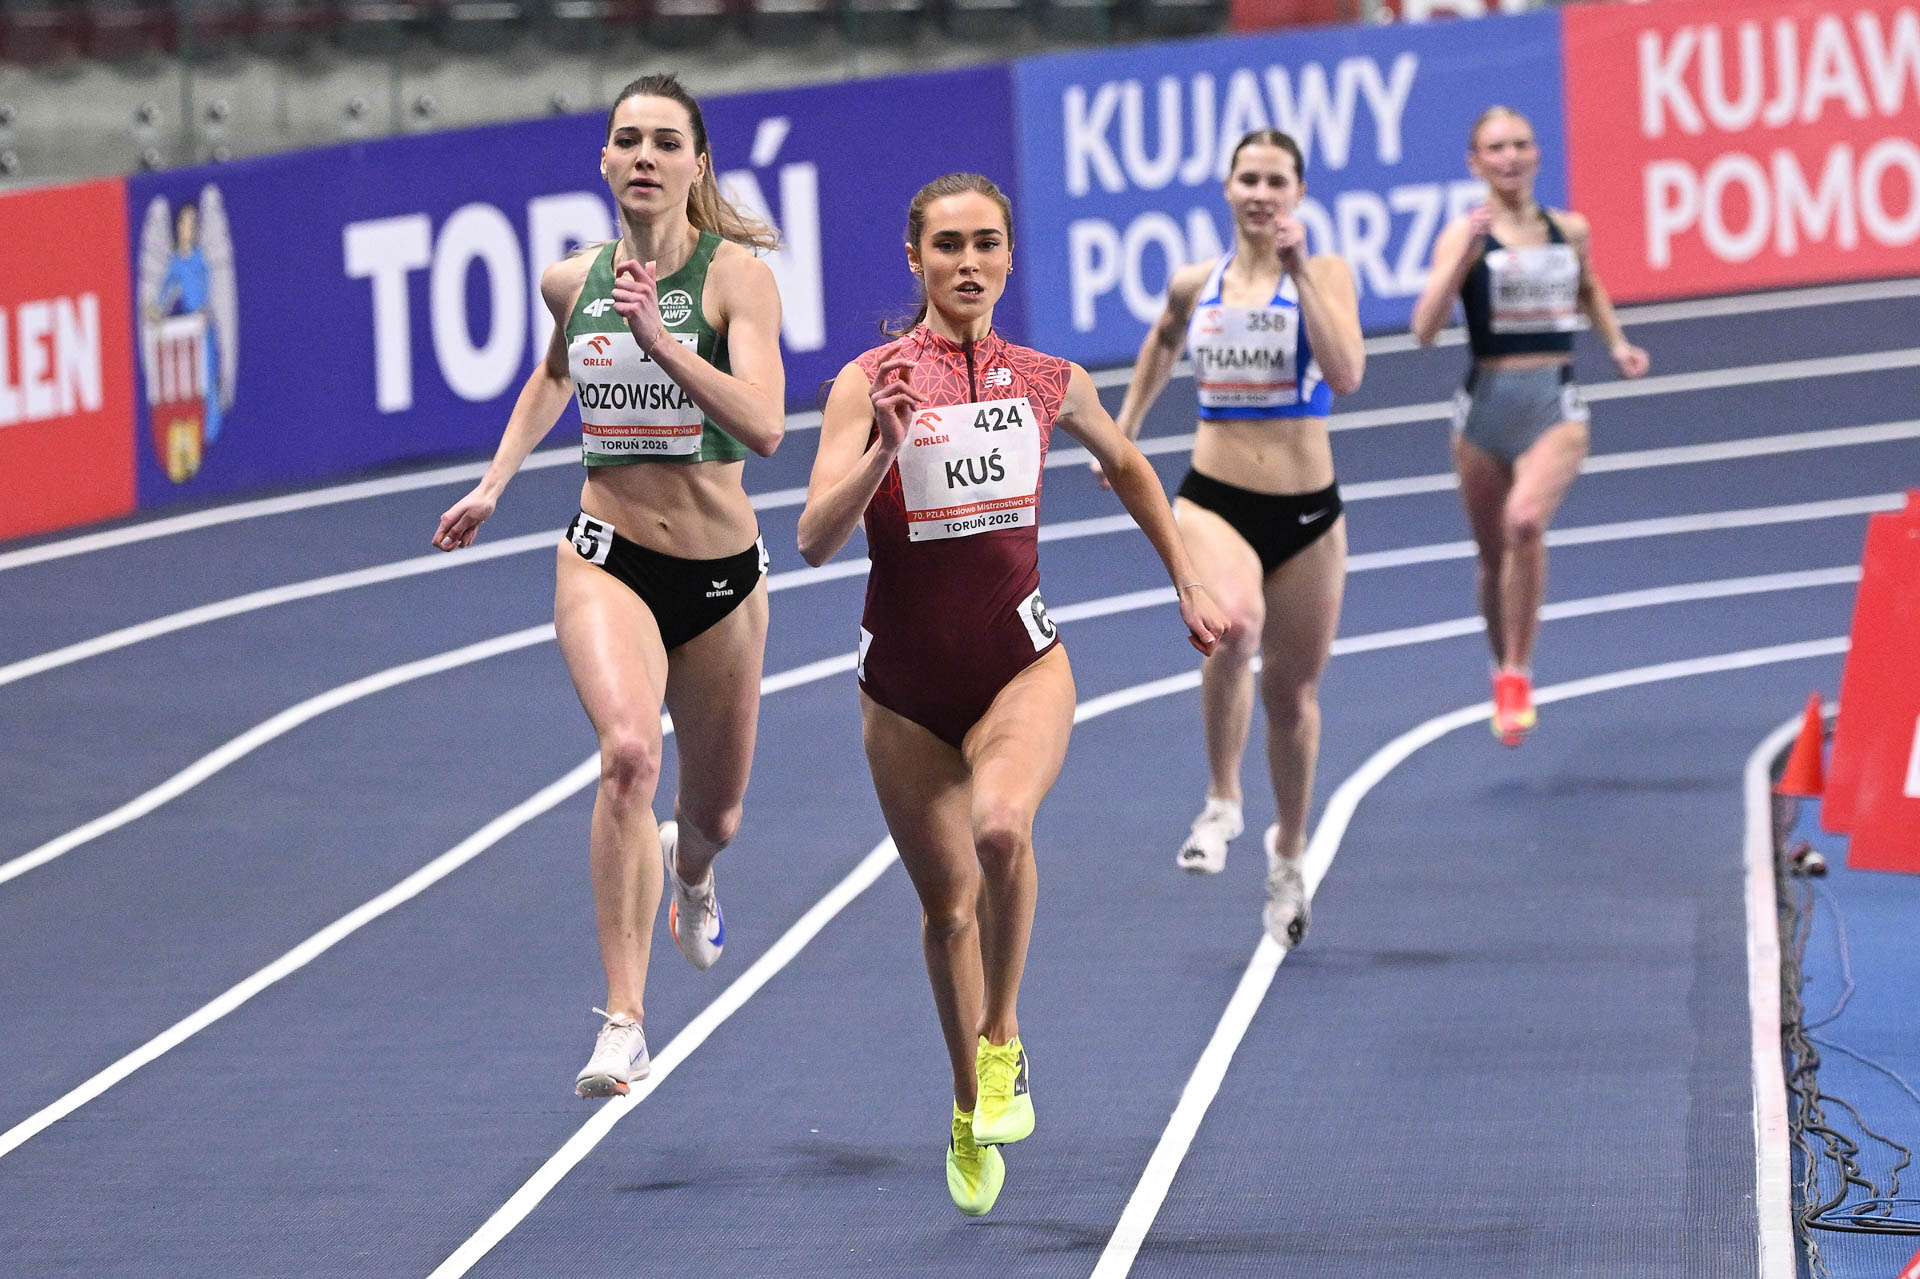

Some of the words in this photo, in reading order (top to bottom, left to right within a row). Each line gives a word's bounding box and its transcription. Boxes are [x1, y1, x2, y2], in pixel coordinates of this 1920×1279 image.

[1639, 9, 1920, 139] KUJAW
[1064, 52, 1419, 196] KUJAWY
[1644, 137, 1920, 270] POMO
[342, 116, 827, 414] TOŃ
[583, 298, 615, 318] 4F
[666, 295, 686, 305] AZS
[662, 310, 687, 320] AWF
[1247, 311, 1288, 333] 358
[583, 358, 613, 366] ORLEN
[1197, 346, 1285, 369] THAMM
[577, 382, 694, 410] ŁOZOWSKA
[603, 427, 629, 435] Halowe
[630, 427, 672, 435] Mistrzostwa
[673, 425, 697, 434] Polski
[974, 405, 1023, 433] 424
[601, 438, 639, 450] TORUŃ
[642, 441, 668, 450] 2026
[914, 434, 950, 447] ORLEN
[944, 448, 1005, 489] KUŚ
[913, 511, 925, 520] 70.
[926, 509, 945, 519] PZLA
[946, 504, 976, 517] Halowe
[977, 498, 1024, 512] Mistrzostwa
[943, 515, 986, 533] TORUŃ
[988, 512, 1019, 526] 2026
[576, 519, 603, 559] 5
[705, 587, 734, 598] erima
